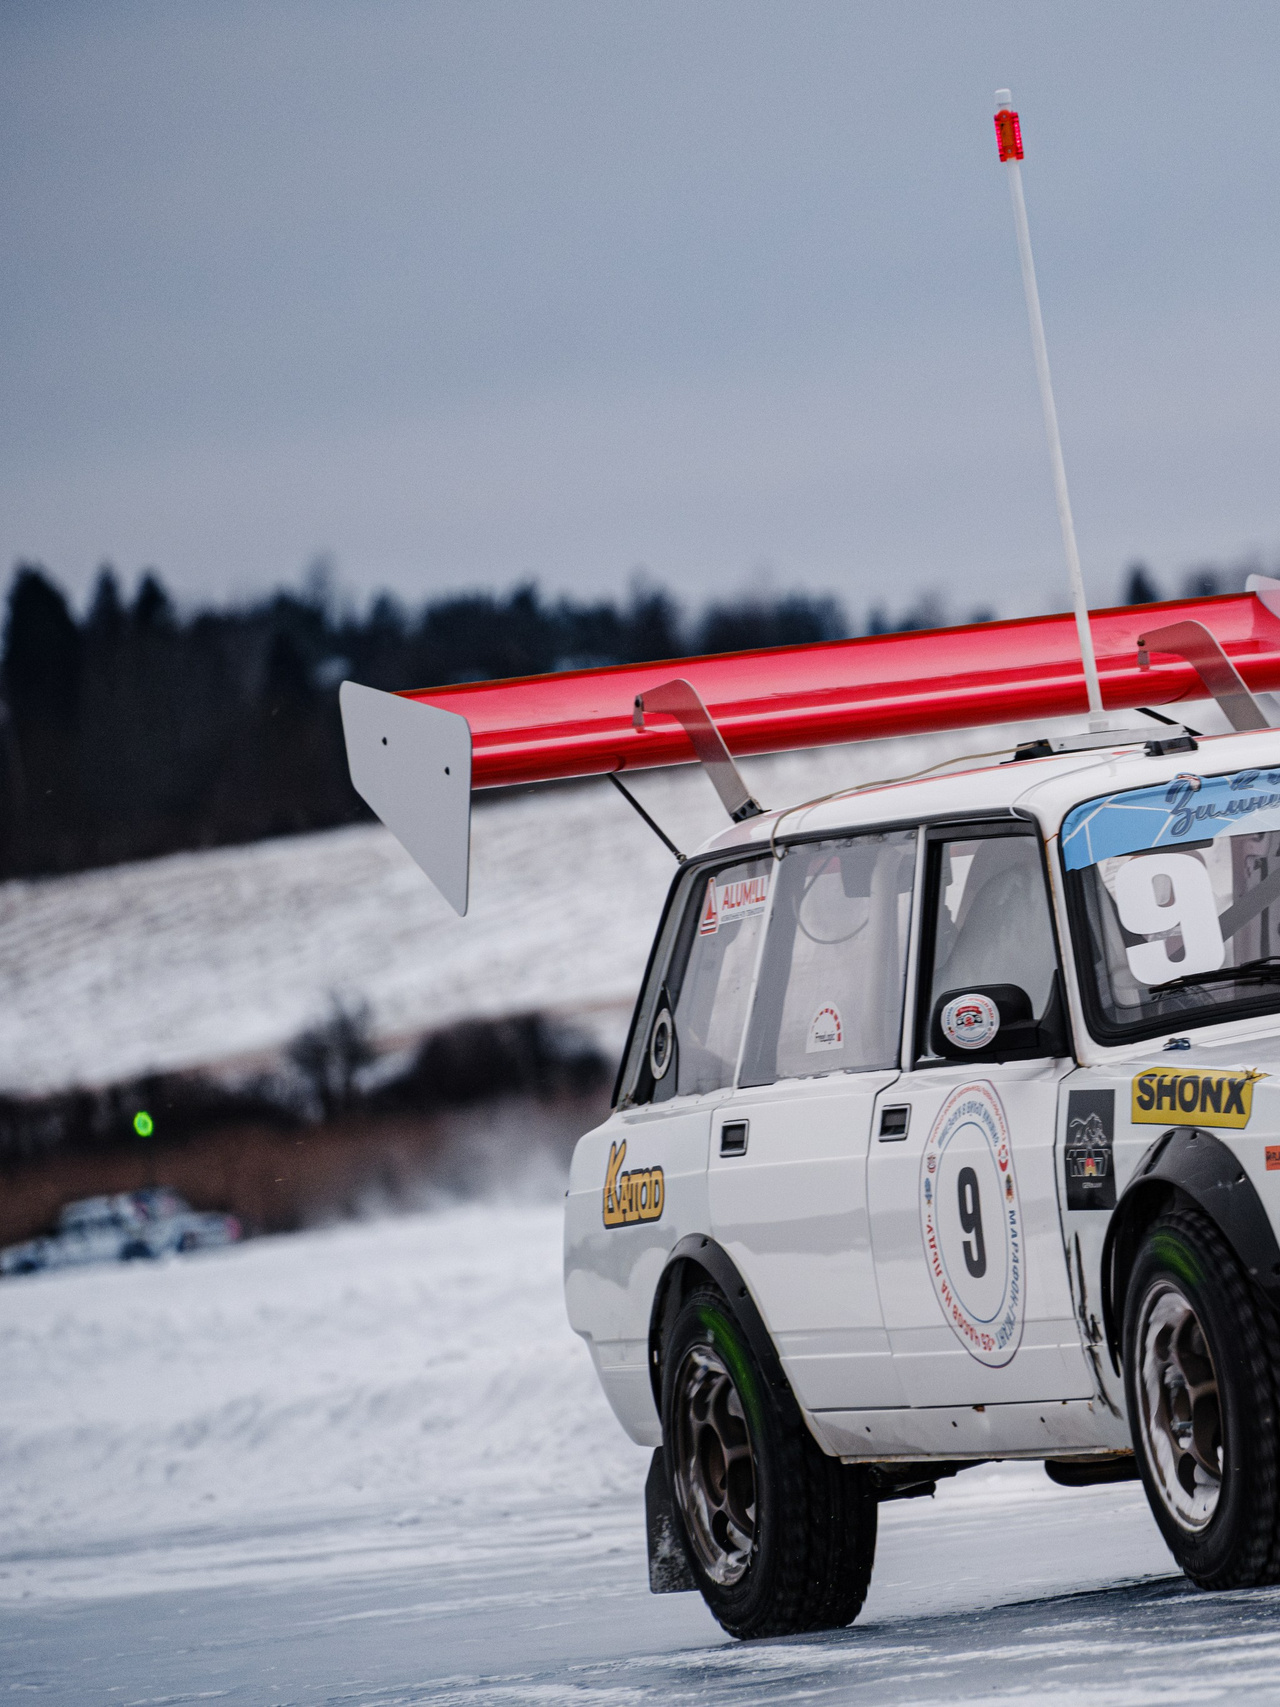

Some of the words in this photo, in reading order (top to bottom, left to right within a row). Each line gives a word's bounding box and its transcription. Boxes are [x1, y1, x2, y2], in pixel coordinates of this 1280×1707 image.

[1114, 853, 1225, 986] 9
[1136, 1073, 1246, 1116] SHONX
[957, 1166, 987, 1279] 9
